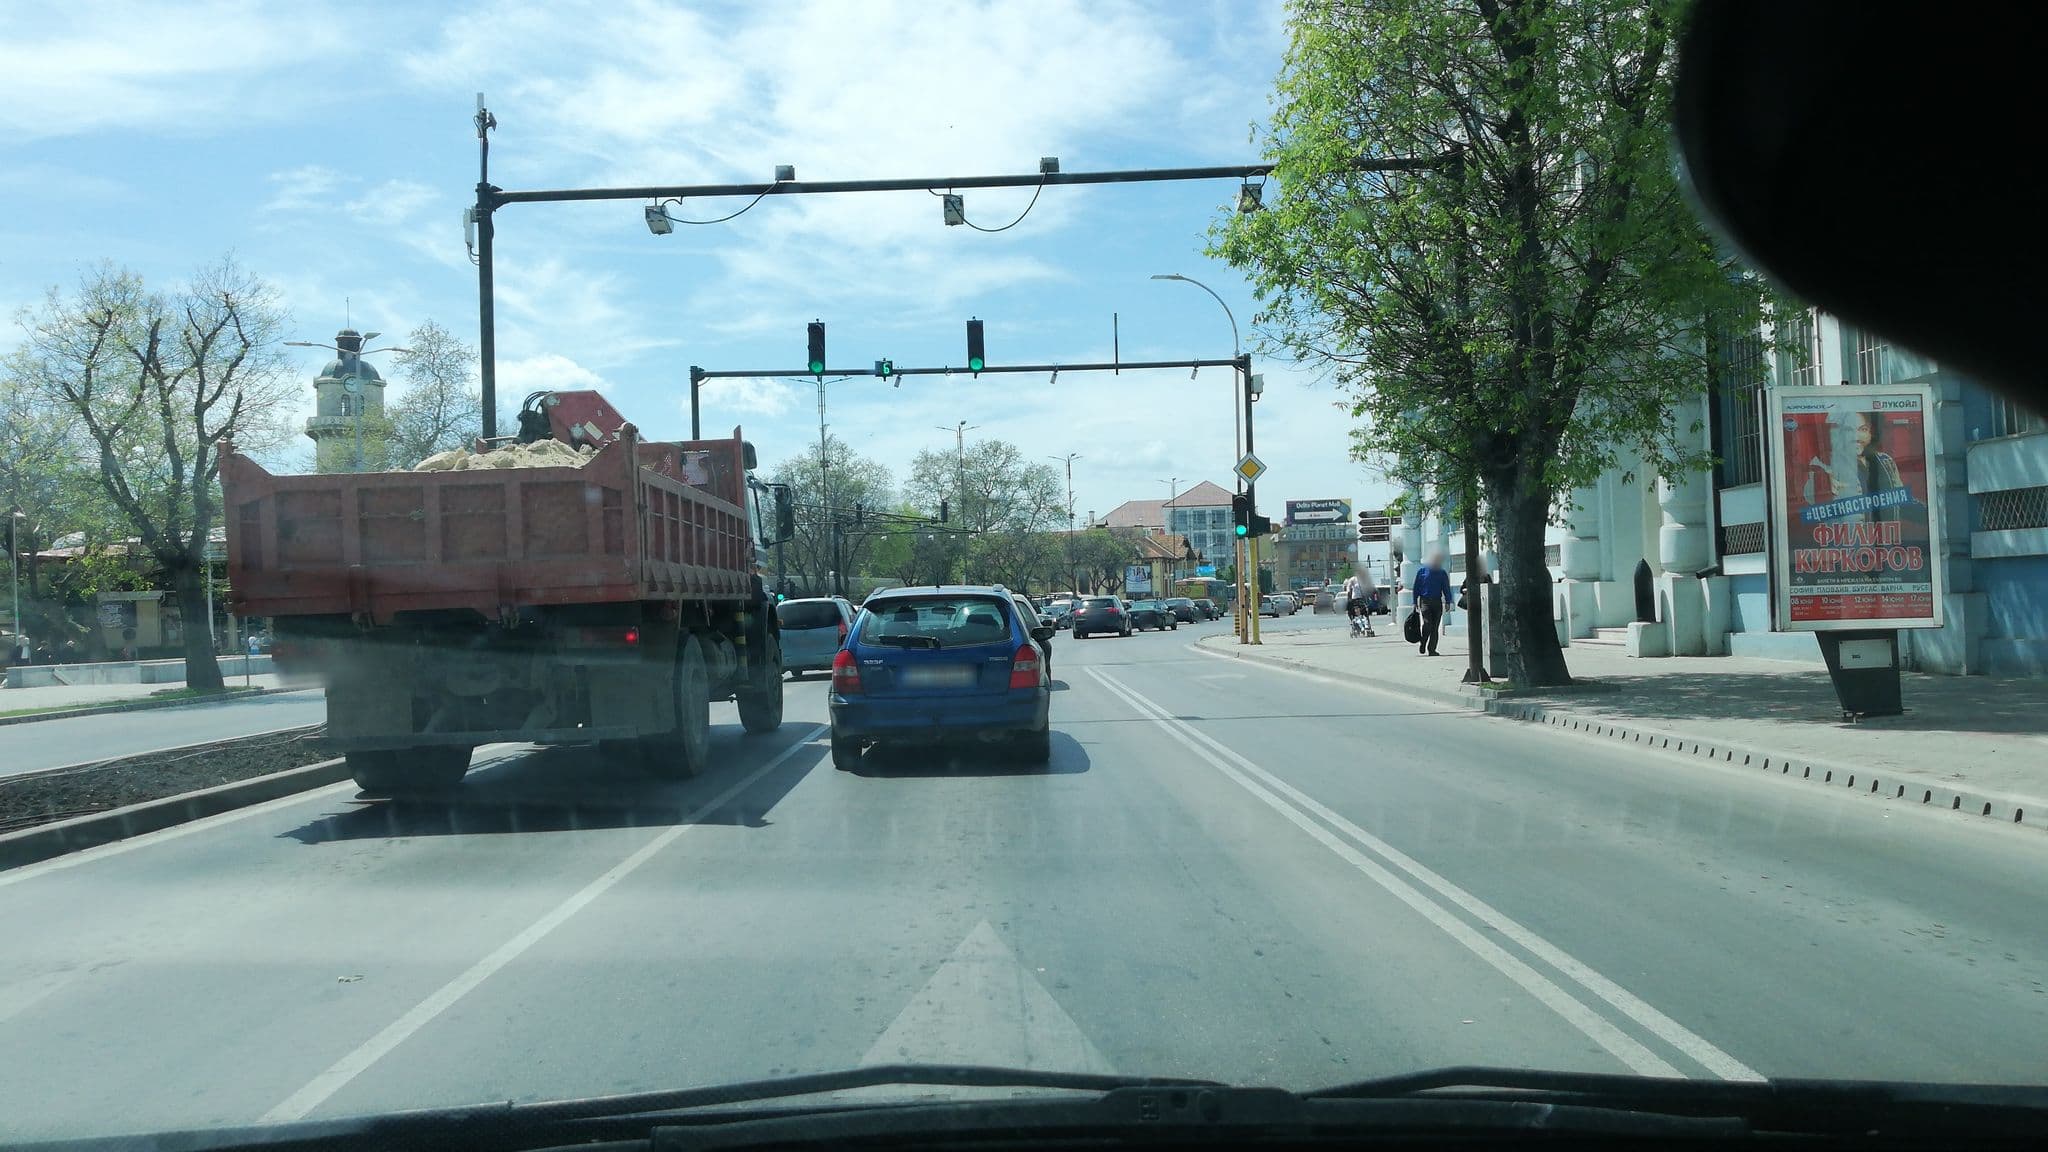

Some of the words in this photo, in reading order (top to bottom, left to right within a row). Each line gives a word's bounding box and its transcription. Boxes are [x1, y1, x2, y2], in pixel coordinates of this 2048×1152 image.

[883, 362, 890, 374] 6
[1880, 400, 1918, 409] ЛУКОЙЛ
[1806, 489, 1908, 521] #ЦВЕТНАСТРОЕНИЯ
[1813, 520, 1902, 547] ФИЛИП
[1794, 546, 1924, 573] КИРКОРОВ
[1790, 586, 1814, 594] СОФИЯ
